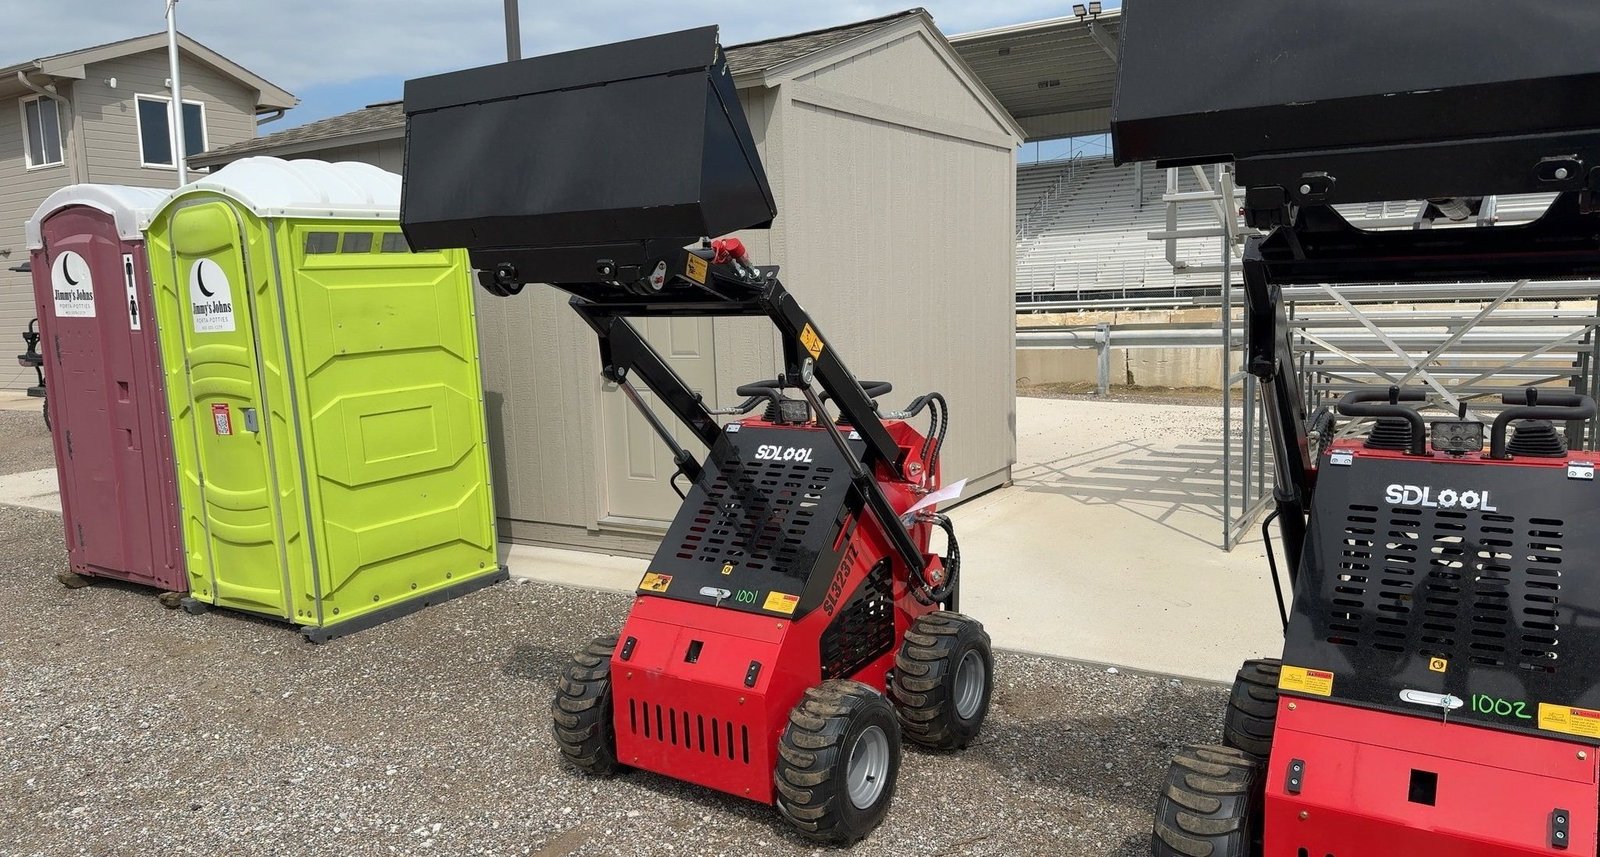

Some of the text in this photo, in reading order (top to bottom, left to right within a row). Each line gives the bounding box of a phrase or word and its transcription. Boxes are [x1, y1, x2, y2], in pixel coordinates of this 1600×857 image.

[55, 289, 93, 302] Jimmy's Johns
[212, 301, 232, 314] Johns
[755, 444, 813, 463] SDLOOL
[1385, 484, 1497, 512] SDLOOL
[735, 589, 759, 604] 1001
[1472, 694, 1532, 719] 1002
